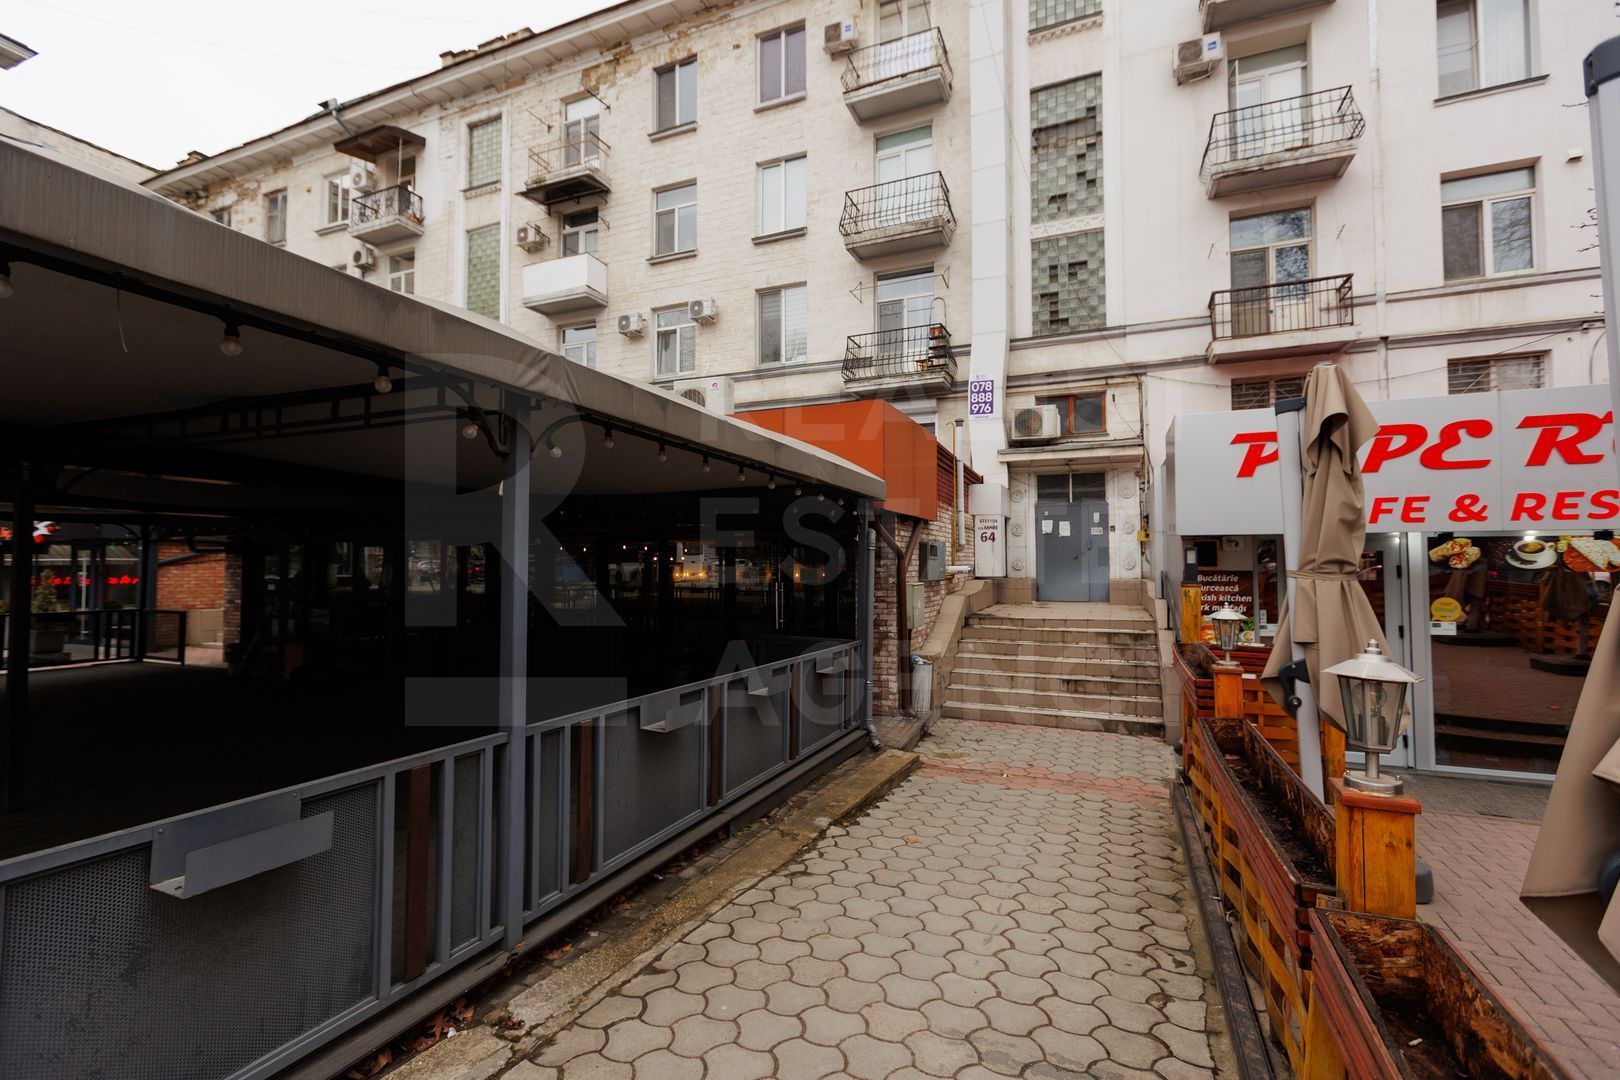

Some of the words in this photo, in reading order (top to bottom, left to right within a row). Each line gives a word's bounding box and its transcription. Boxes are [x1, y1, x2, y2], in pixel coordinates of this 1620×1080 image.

[971, 381, 993, 392] 078
[971, 392, 993, 403] 888
[971, 402, 992, 414] 976
[980, 531, 996, 543] 64
[1201, 584, 1239, 592] urcească
[1218, 593, 1252, 602] kitchen
